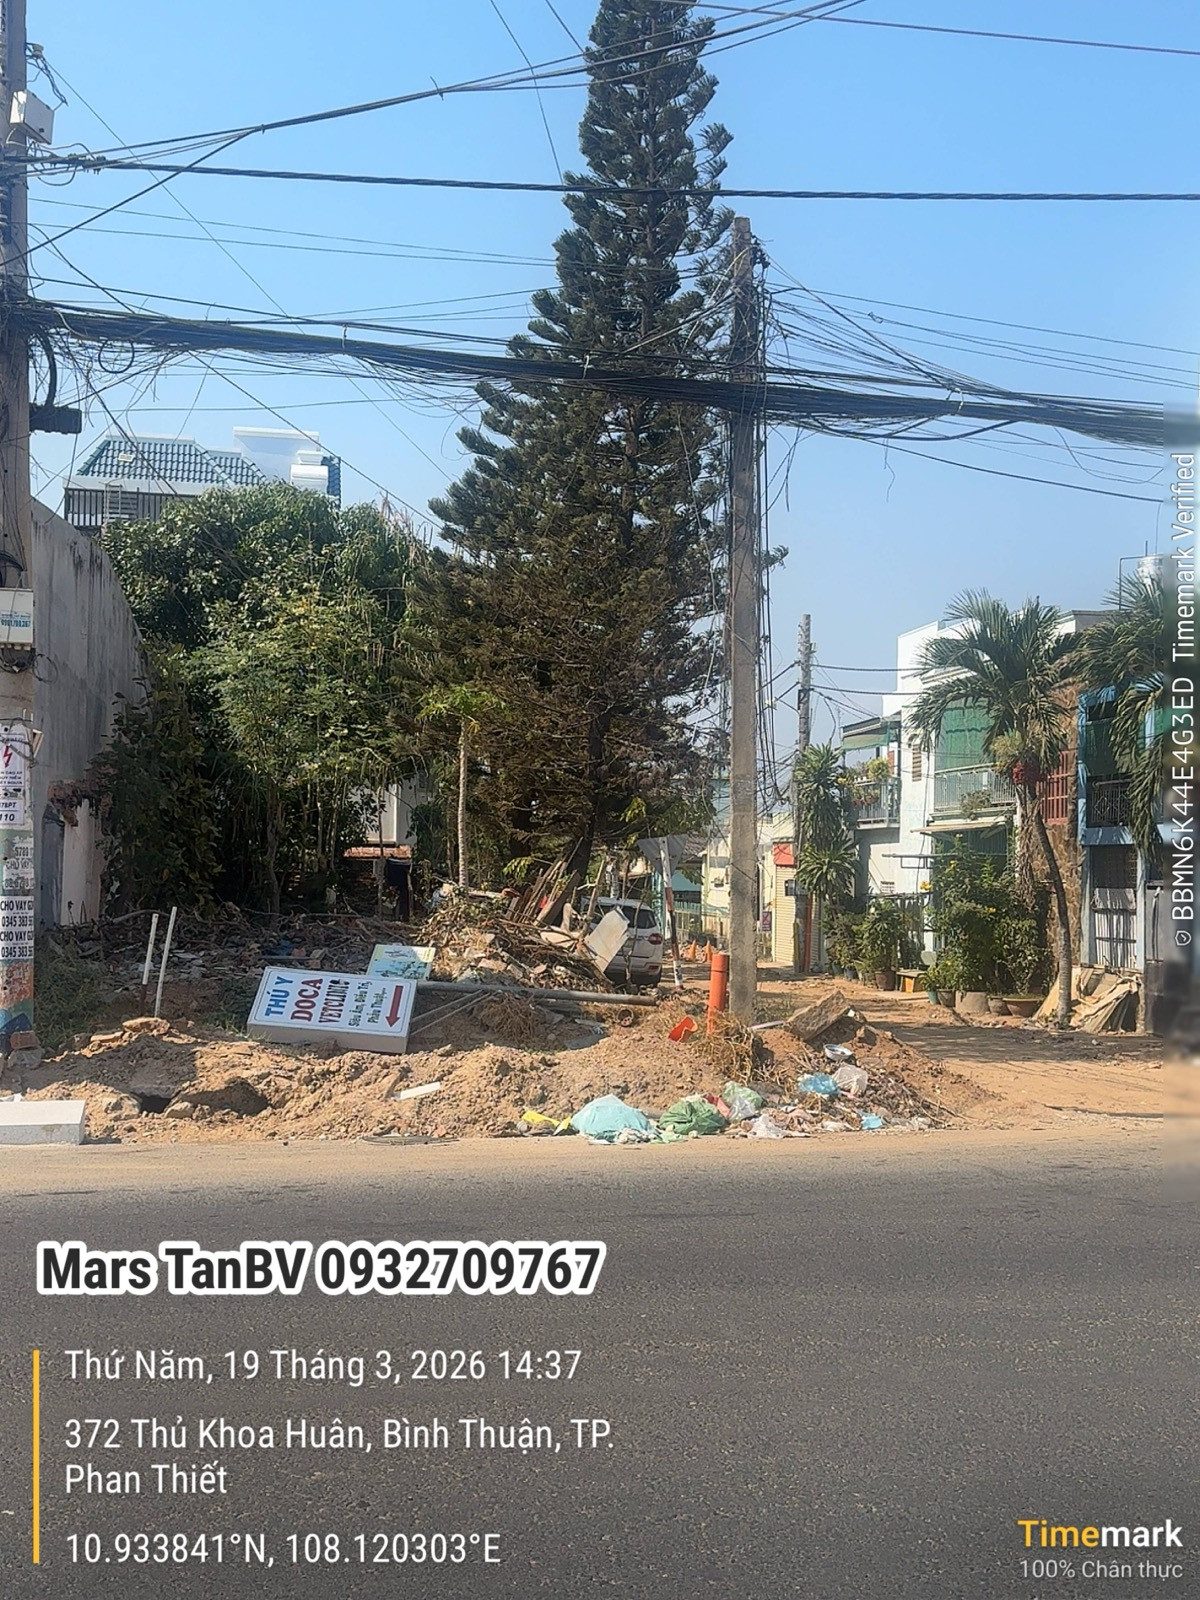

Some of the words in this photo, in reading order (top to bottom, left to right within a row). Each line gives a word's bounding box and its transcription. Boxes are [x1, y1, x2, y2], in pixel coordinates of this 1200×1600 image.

[0, 900, 14, 911] CHO
[15, 900, 26, 911] VAY
[0, 931, 14, 942] CHO
[15, 931, 26, 942] VAY
[275, 976, 294, 985] Y
[265, 988, 291, 1017] THÚ
[290, 978, 323, 1022] DOCA
